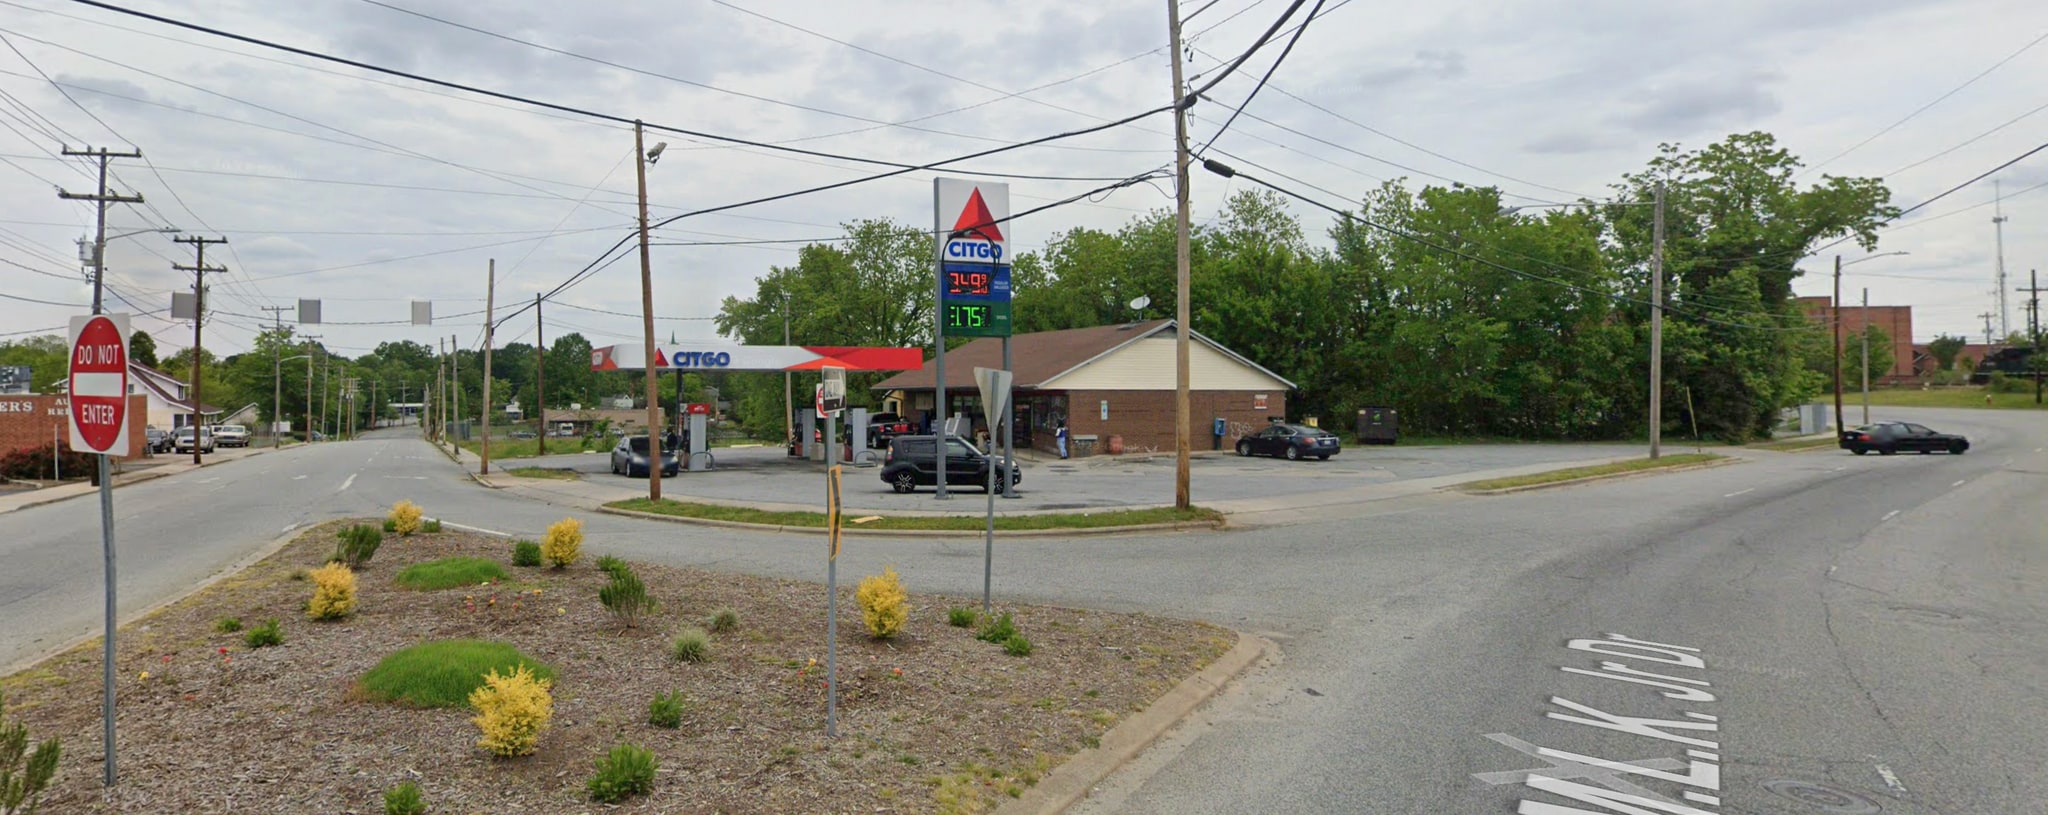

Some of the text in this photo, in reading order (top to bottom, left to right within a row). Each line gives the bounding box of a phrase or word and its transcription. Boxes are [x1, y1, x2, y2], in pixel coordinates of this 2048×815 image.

[948, 241, 1003, 259] CITGO
[78, 344, 119, 365] DO NOT
[673, 351, 730, 367] CITGO
[82, 403, 115, 425] ENTER
